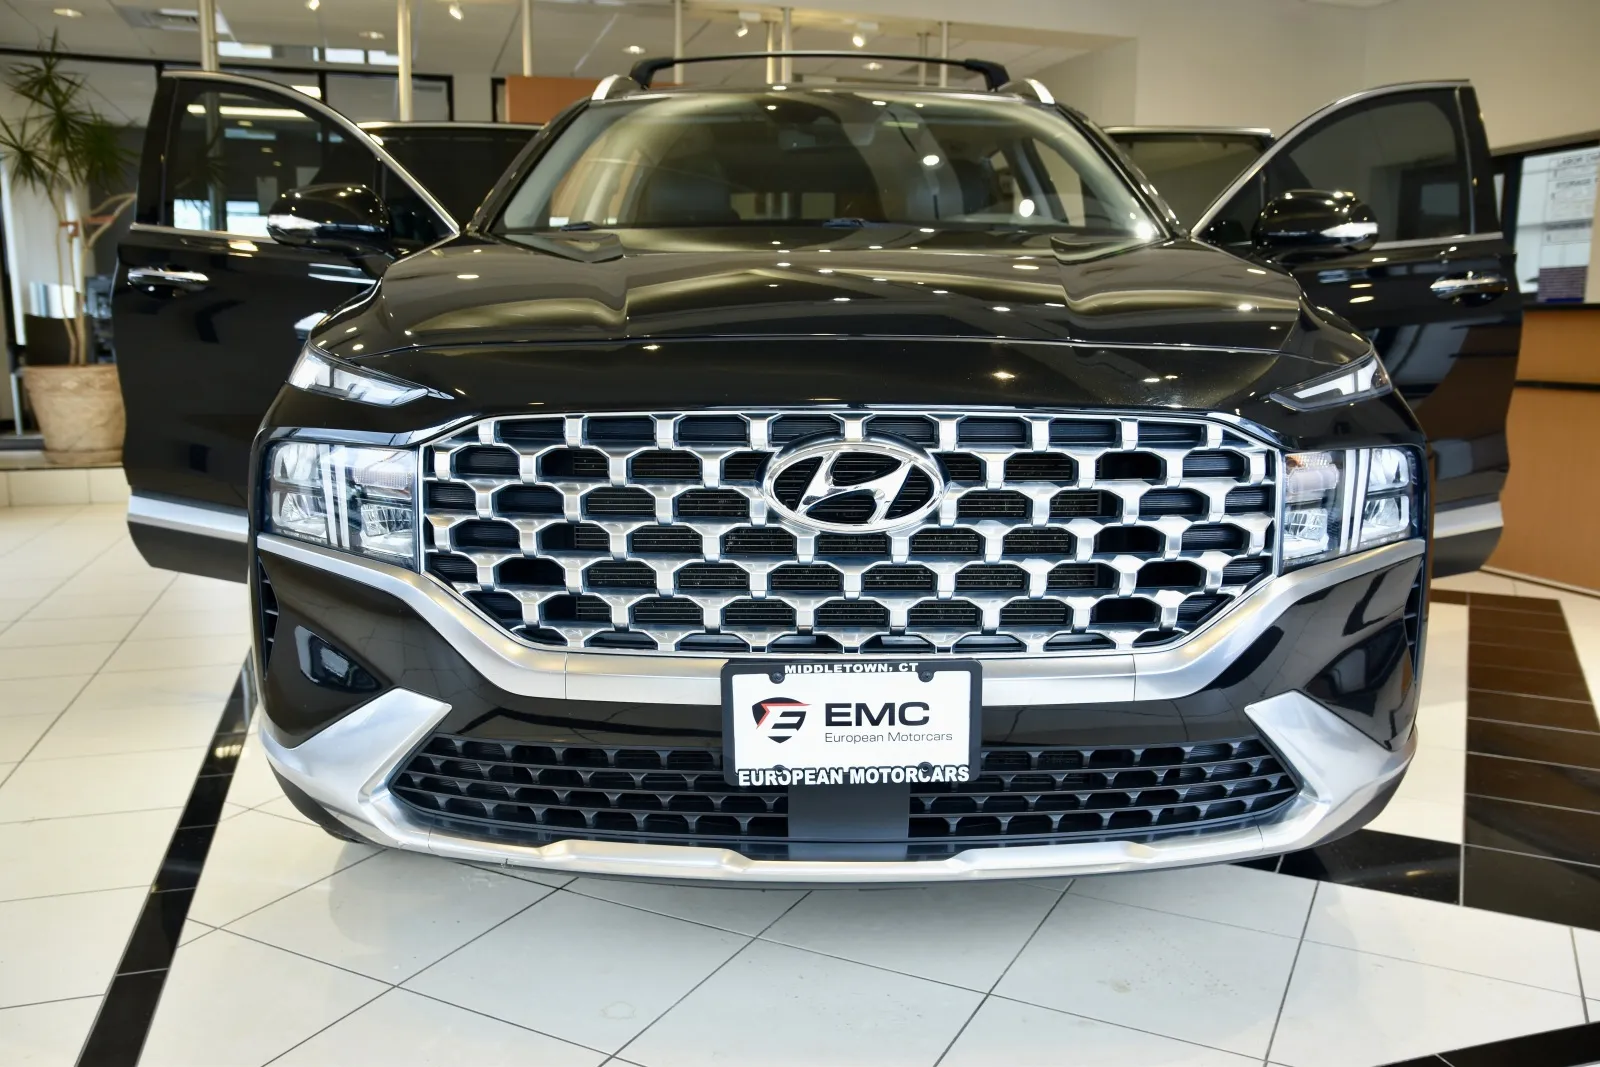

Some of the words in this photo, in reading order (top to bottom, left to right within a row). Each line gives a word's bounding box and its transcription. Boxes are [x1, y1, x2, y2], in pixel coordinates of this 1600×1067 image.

[784, 664, 893, 673] MIDDLETOWN,
[898, 662, 919, 672] CT
[825, 701, 930, 727] EMC
[825, 733, 884, 744] European
[888, 732, 953, 742] Motorcars
[738, 768, 844, 786] EUROPEAN
[849, 766, 970, 784] MOTORCARS
